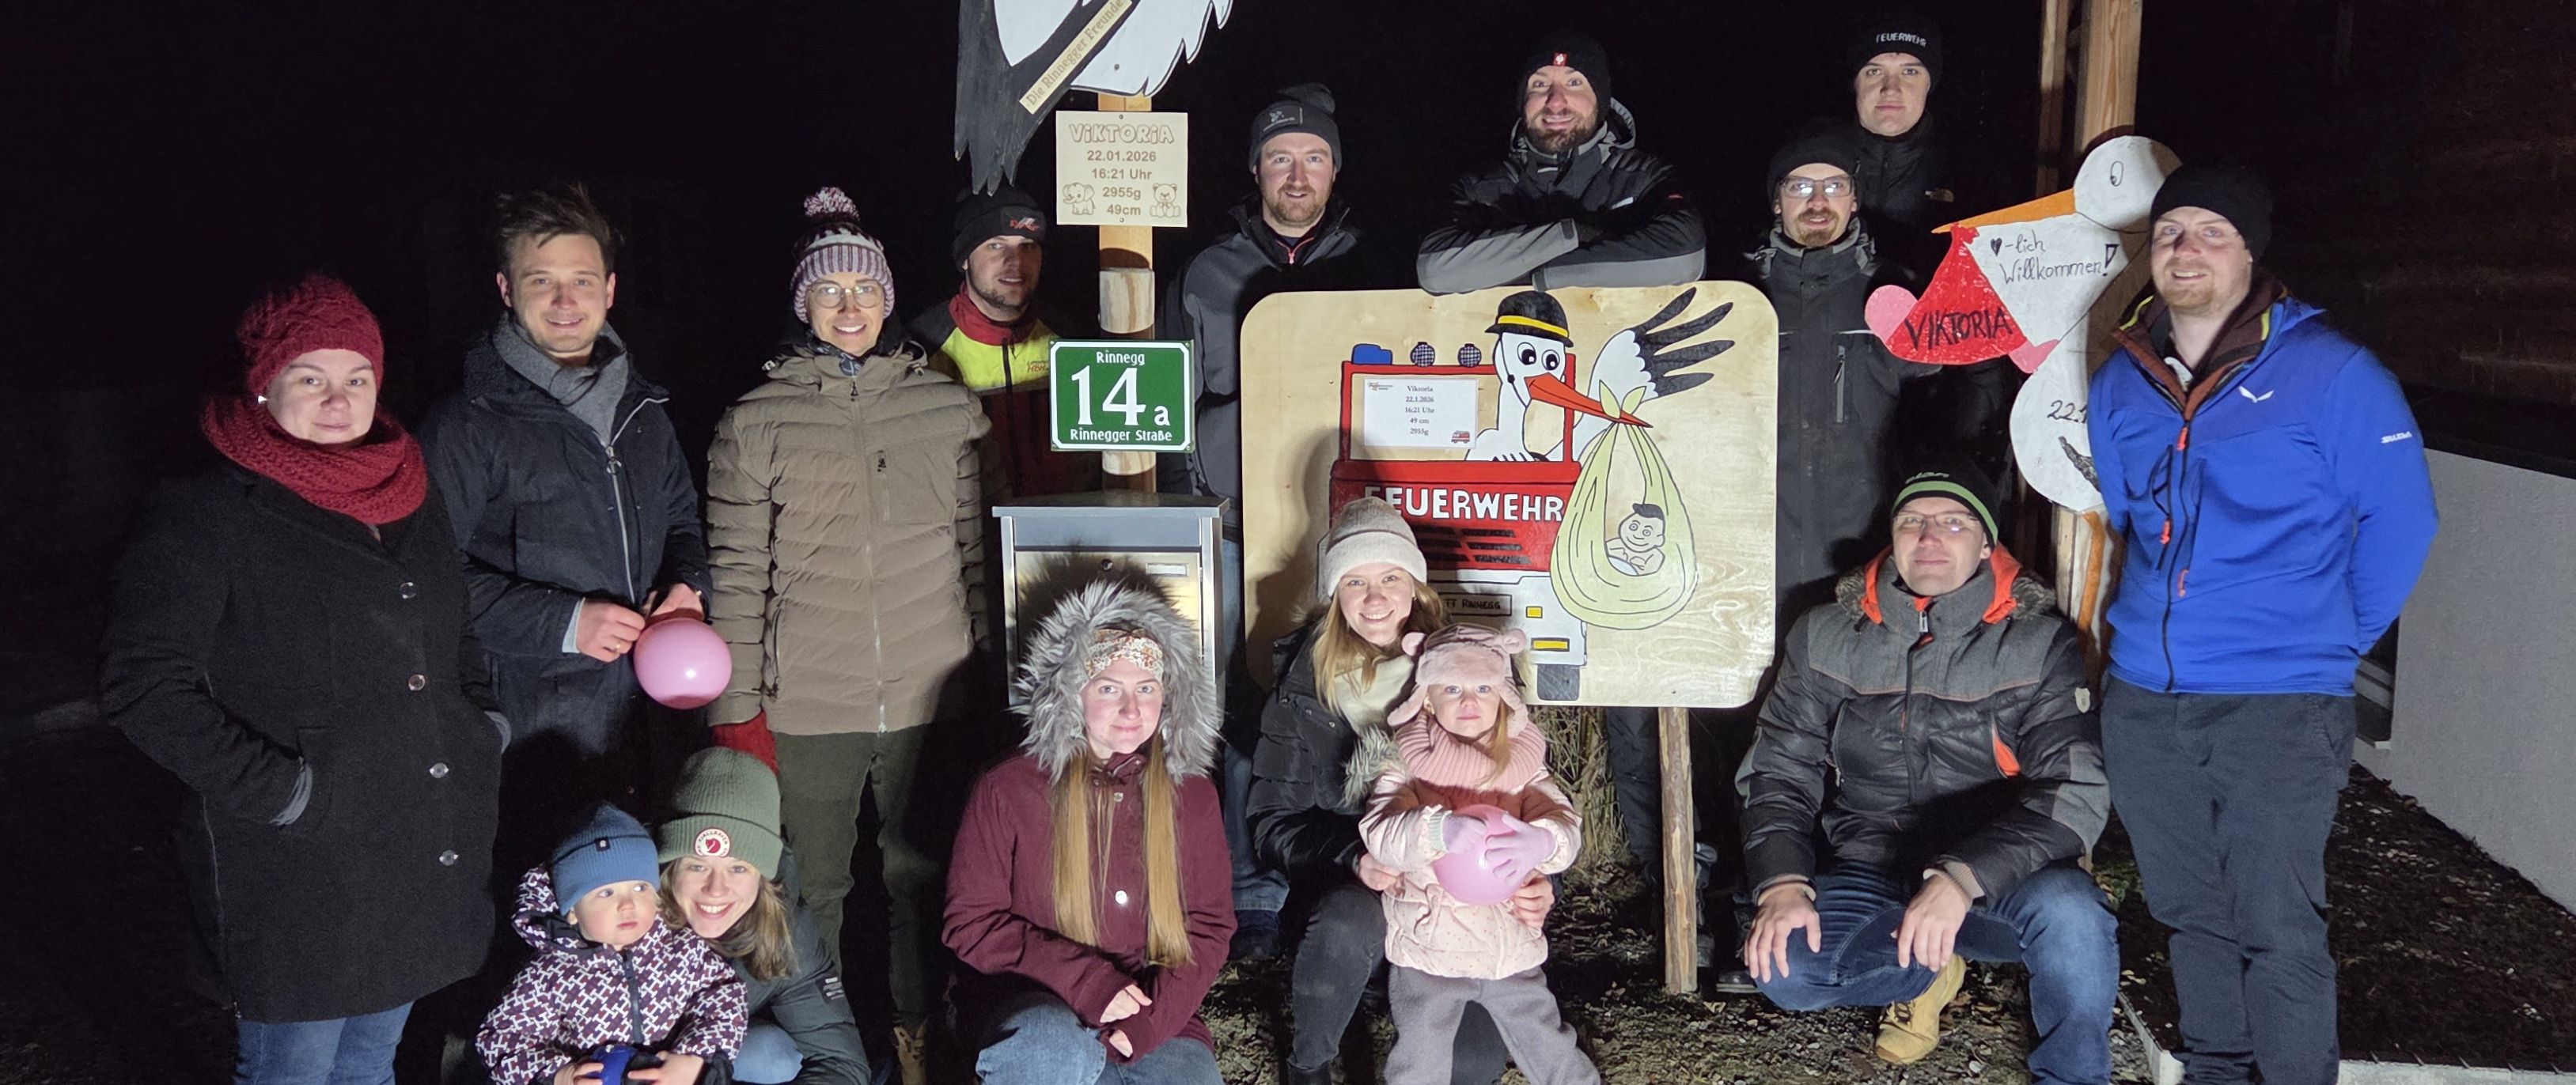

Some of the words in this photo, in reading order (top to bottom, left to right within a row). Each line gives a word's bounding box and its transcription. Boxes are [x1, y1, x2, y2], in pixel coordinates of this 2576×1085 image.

[1026, 88, 1046, 105] Die
[1042, 38, 1089, 89] Rinnegger
[1084, 0, 1123, 40] Freunde
[1086, 149, 1157, 161] 22.01.2026
[1092, 168, 1124, 179] 16:21
[1129, 168, 1153, 180] Uhr
[1102, 187, 1142, 200] 2955g
[1106, 204, 1142, 215] 49cm
[1999, 244, 2120, 285] Willkommen!
[1904, 307, 2013, 351] VIKTORIA
[1096, 350, 1146, 366] Rinnegg
[1071, 365, 1146, 425] 14
[1154, 405, 1171, 426] a
[1070, 427, 1131, 443] Rinnegger
[1135, 429, 1172, 441] Straße
